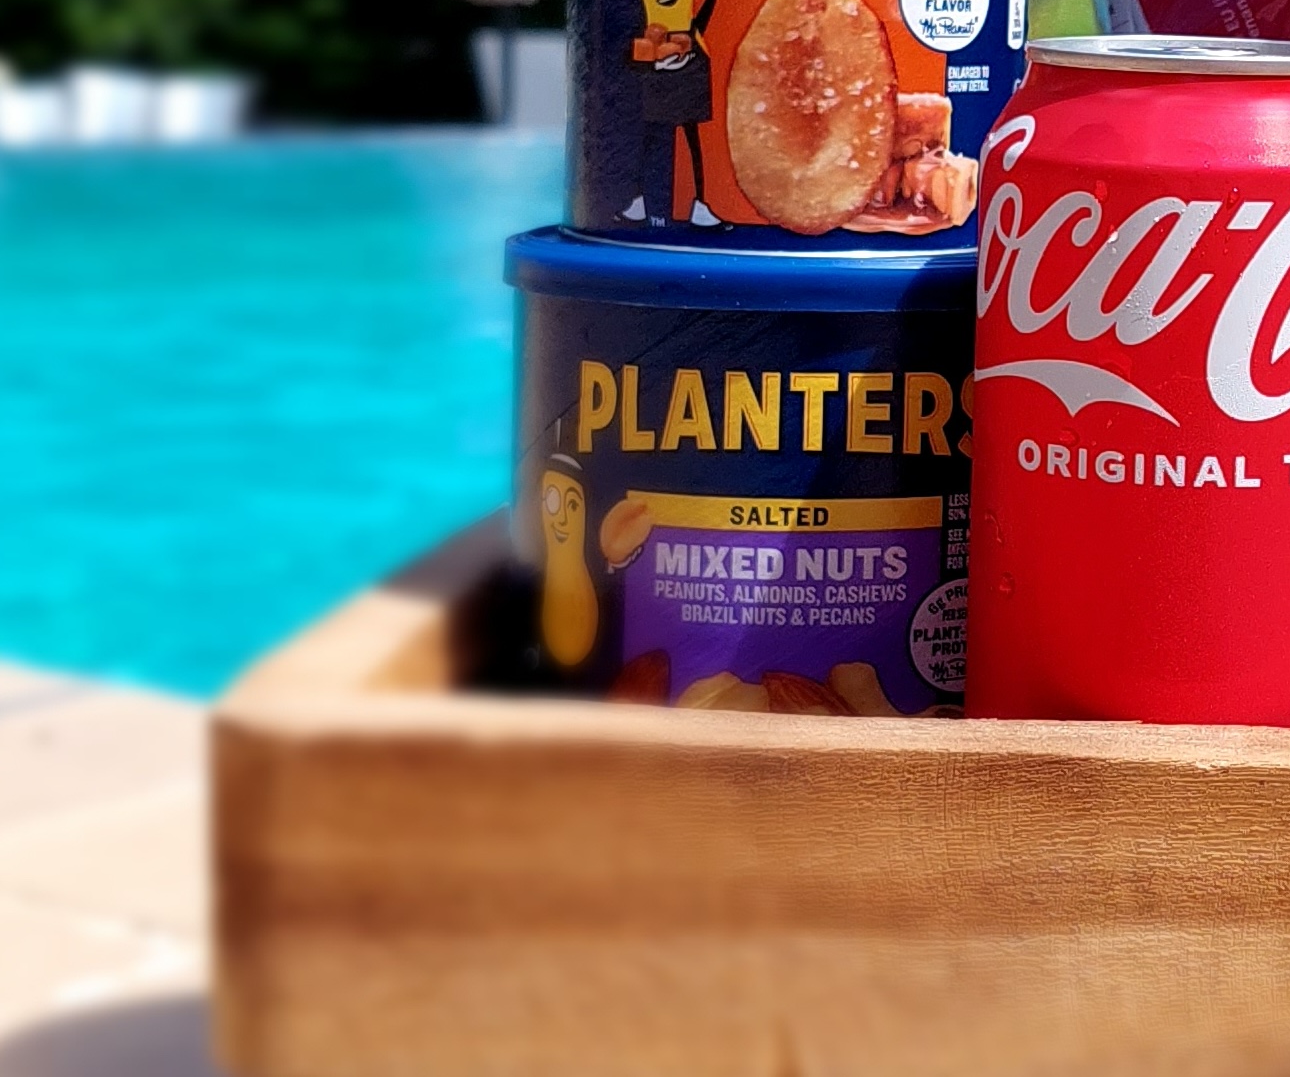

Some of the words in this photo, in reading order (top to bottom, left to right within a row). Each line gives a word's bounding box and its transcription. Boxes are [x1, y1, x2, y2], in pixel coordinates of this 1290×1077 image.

[925, 0, 972, 12] FLAVOR
[1017, 438, 1262, 489] ORIGINAL
[729, 505, 829, 527] SALTED
[655, 542, 784, 581] MIXED
[795, 546, 908, 582] NUTS
[653, 580, 730, 605] PEANUTS,
[733, 583, 821, 607] ALMONDS,
[825, 584, 907, 604] CASHEWS
[681, 604, 738, 624] BRAZIL
[742, 606, 787, 625] NUTS
[790, 607, 808, 626] &
[809, 606, 876, 626] PECANS
